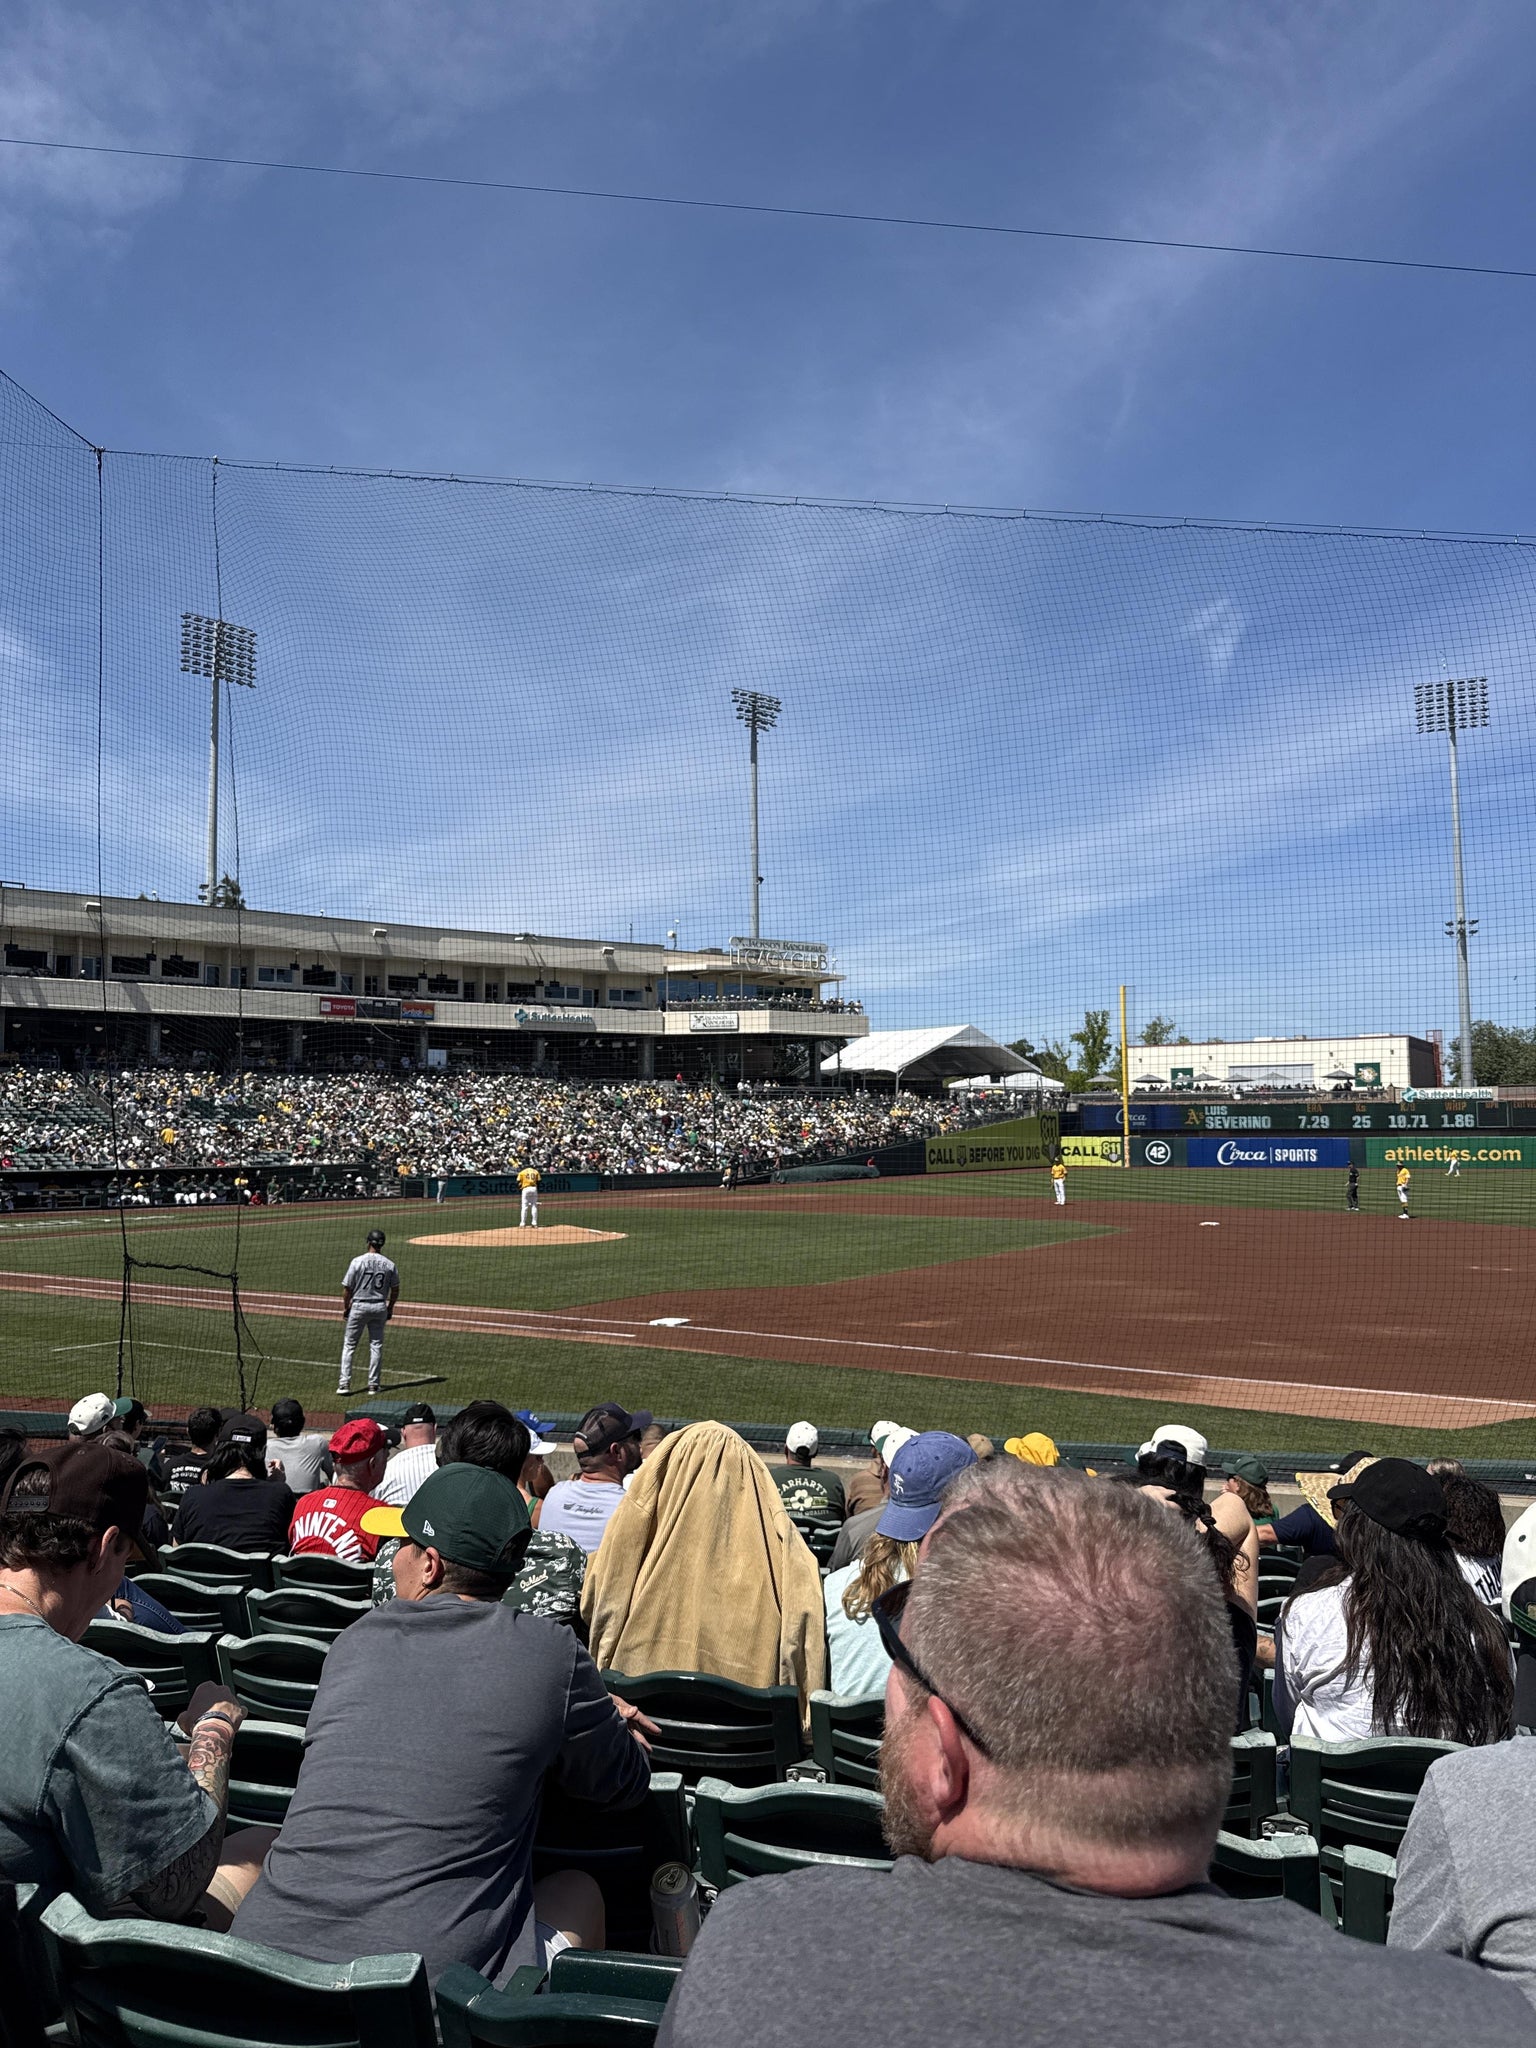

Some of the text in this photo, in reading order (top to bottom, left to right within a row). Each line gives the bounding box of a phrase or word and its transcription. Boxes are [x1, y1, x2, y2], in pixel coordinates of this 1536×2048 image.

[748, 939, 780, 949] JACKSON
[790, 952, 828, 970] CLUB
[1205, 1106, 1227, 1115] LUIS
[1307, 1104, 1323, 1112] ERA
[1445, 1101, 1467, 1111] WHIP
[1115, 1108, 1147, 1124] Crca
[1205, 1116, 1271, 1129] SEVERINO
[1298, 1115, 1330, 1128] 7.29
[1352, 1115, 1371, 1128] 25
[1441, 1114, 1475, 1128] 1.86
[928, 1148, 955, 1165] CALL
[969, 1147, 1005, 1163] BEFORE
[1006, 1146, 1025, 1161] YOU
[1026, 1145, 1041, 1161] DIG
[1061, 1141, 1121, 1157] CALL 811
[1149, 1147, 1166, 1159] 42
[1217, 1141, 1317, 1166] Circa SPORTS
[362, 1272, 385, 1290] 73
[294, 1511, 361, 1563] NINTEND
[520, 1569, 549, 1592] Oakland
